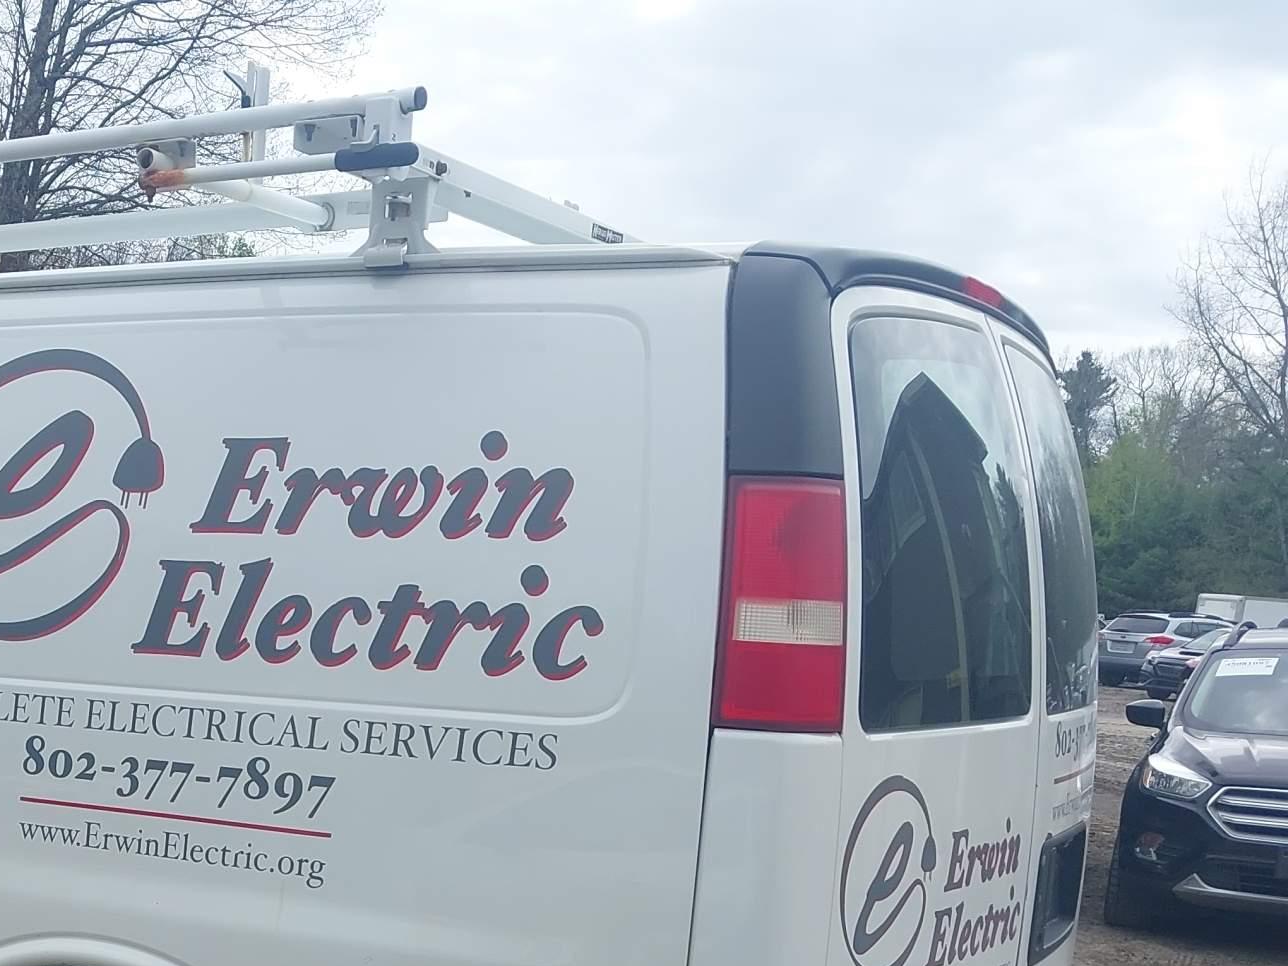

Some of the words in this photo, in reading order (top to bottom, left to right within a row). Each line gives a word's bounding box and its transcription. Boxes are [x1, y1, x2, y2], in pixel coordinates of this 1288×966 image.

[190, 430, 575, 541] Erwin
[130, 557, 605, 681] Electric
[84, 698, 330, 752] ELECTRICAL
[339, 718, 559, 771] SERVICES
[22, 735, 337, 820] 802-377-7897
[18, 819, 327, 889] www.ErwinElectric.org
[944, 817, 1021, 893] Erwin
